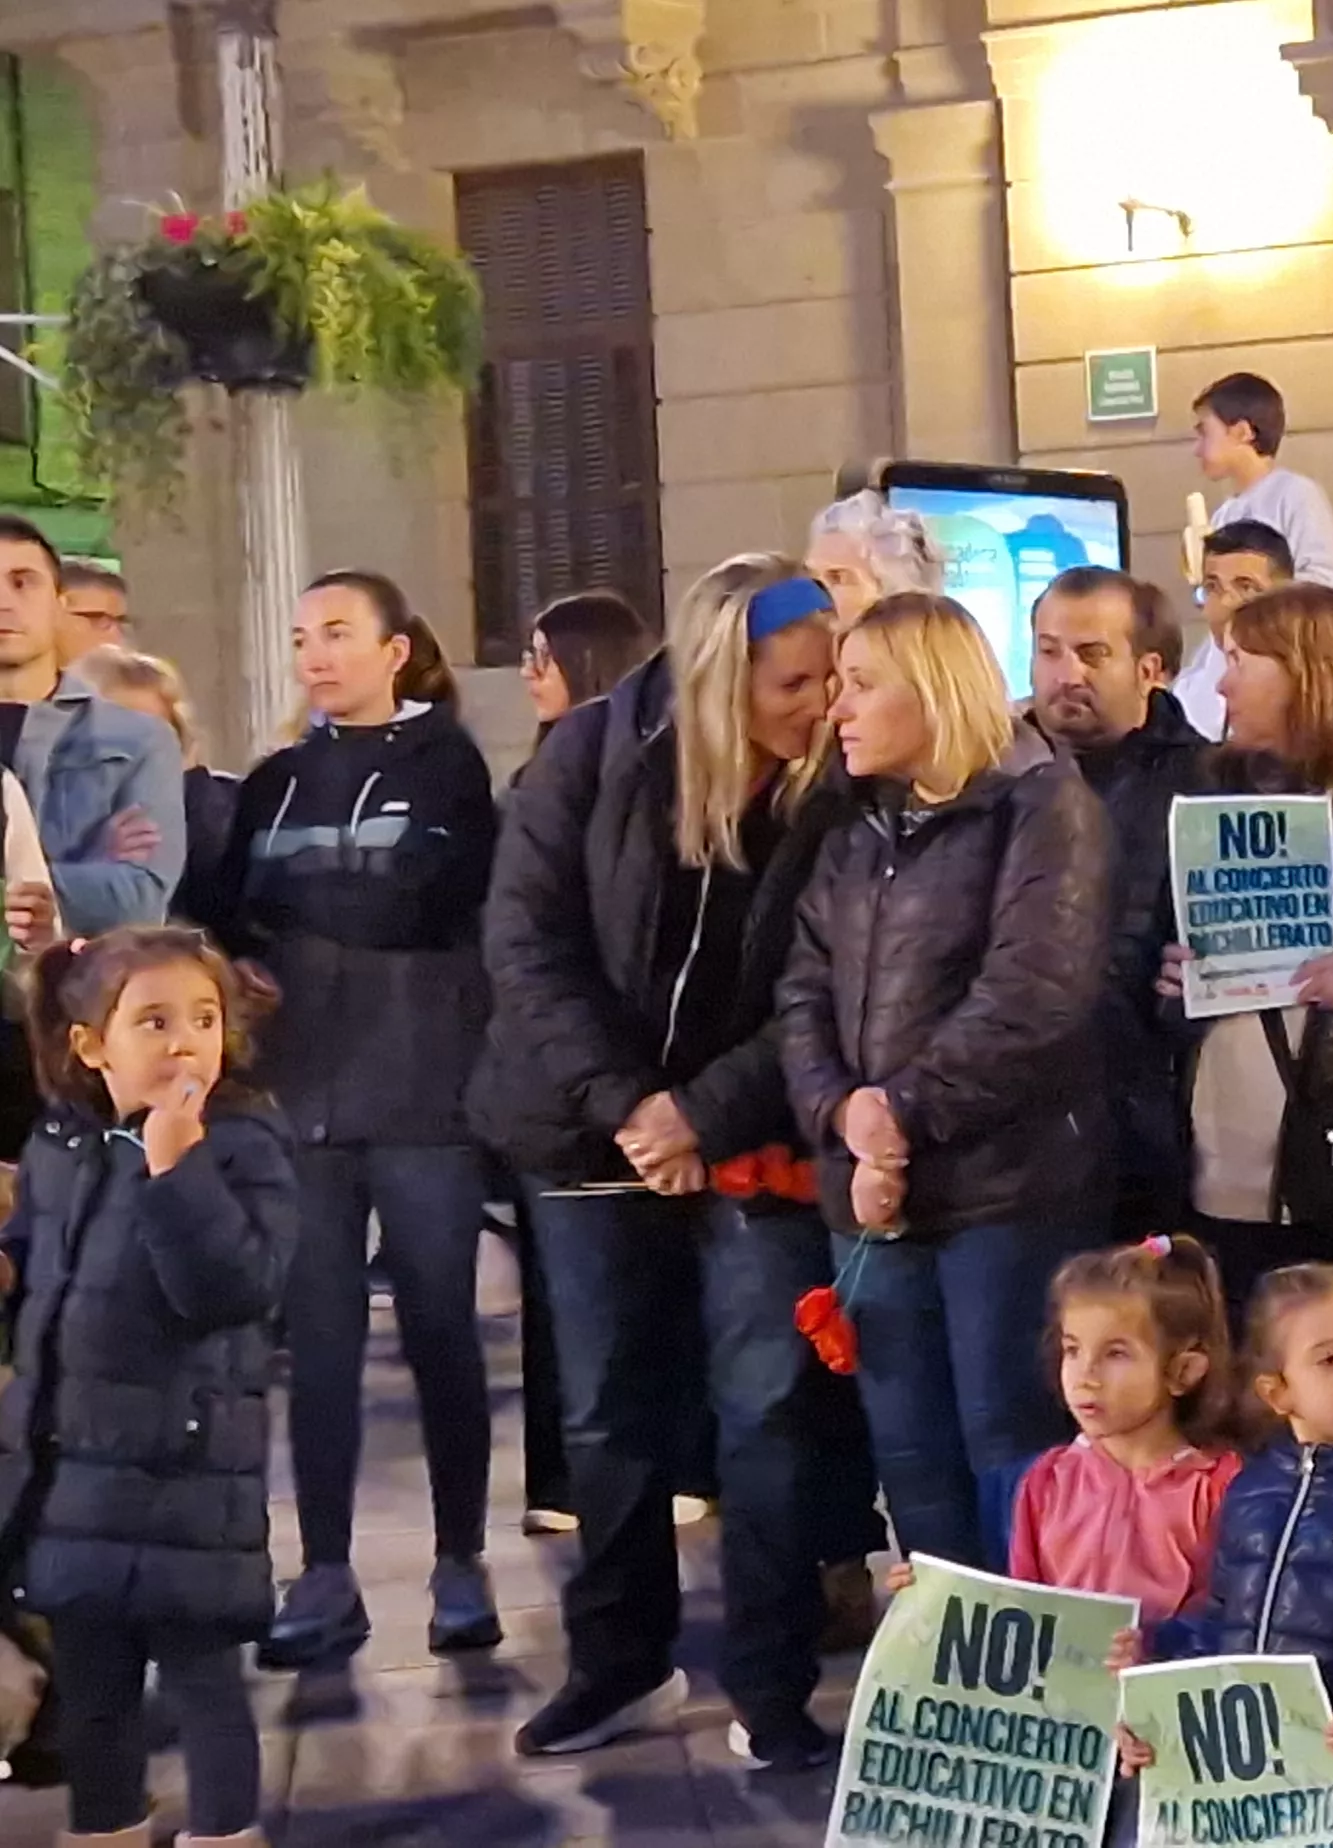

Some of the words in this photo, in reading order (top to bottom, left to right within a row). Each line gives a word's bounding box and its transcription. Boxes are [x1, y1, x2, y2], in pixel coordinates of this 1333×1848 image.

[1219, 810, 1288, 860] NO!
[933, 1594, 1057, 1701] NO!
[866, 1687, 905, 1735] AL
[913, 1695, 1102, 1770] CONCIERTO
[1177, 1682, 1286, 1782] NO!
[860, 1739, 1043, 1814] EDUCATIVO
[1048, 1774, 1095, 1823] EN
[1155, 1801, 1185, 1845] AL
